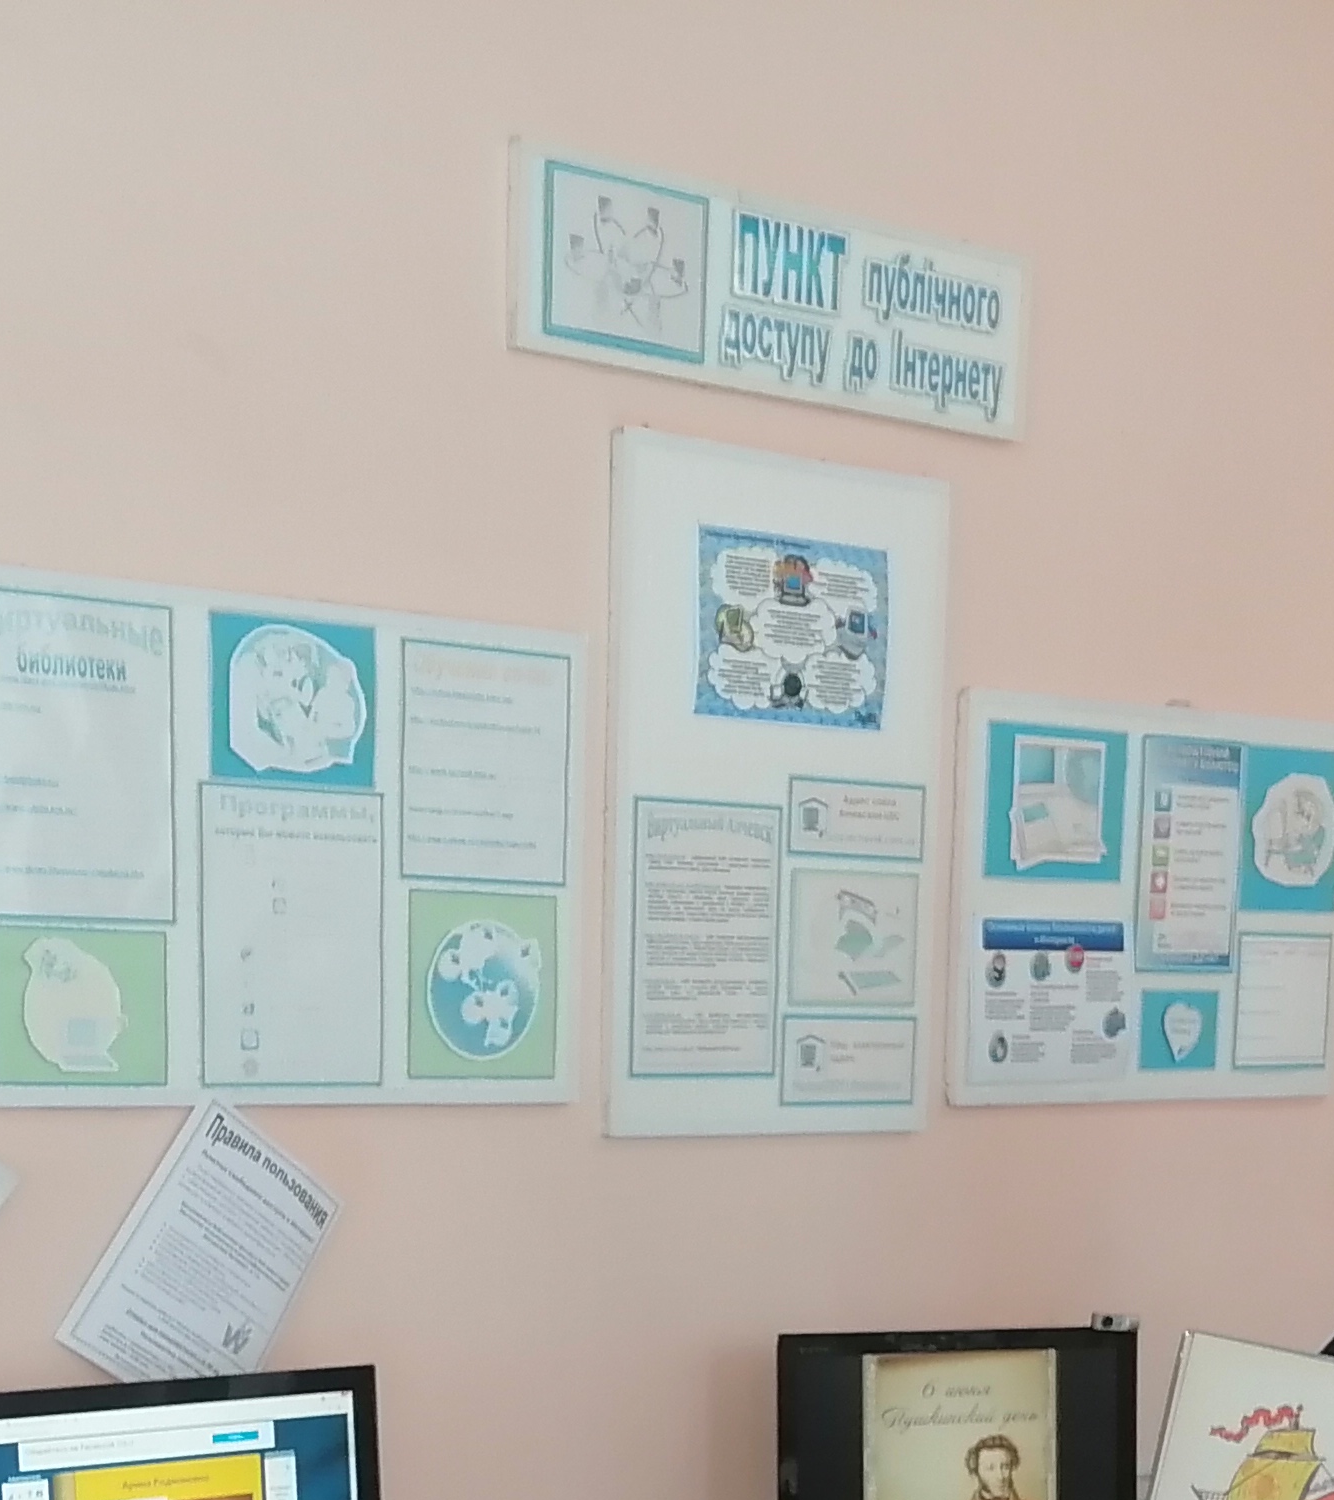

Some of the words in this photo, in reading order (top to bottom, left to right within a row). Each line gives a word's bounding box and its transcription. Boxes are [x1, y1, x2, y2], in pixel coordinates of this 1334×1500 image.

[736, 213, 847, 311] ПУНКТ
[867, 254, 1002, 330] публічного
[723, 310, 831, 384] доступу
[847, 337, 879, 388] до
[893, 332, 1003, 420] Інтернету
[16, 641, 127, 682] библиотеки
[204, 1113, 263, 1167] Правила
[261, 1155, 329, 1230] пользования
